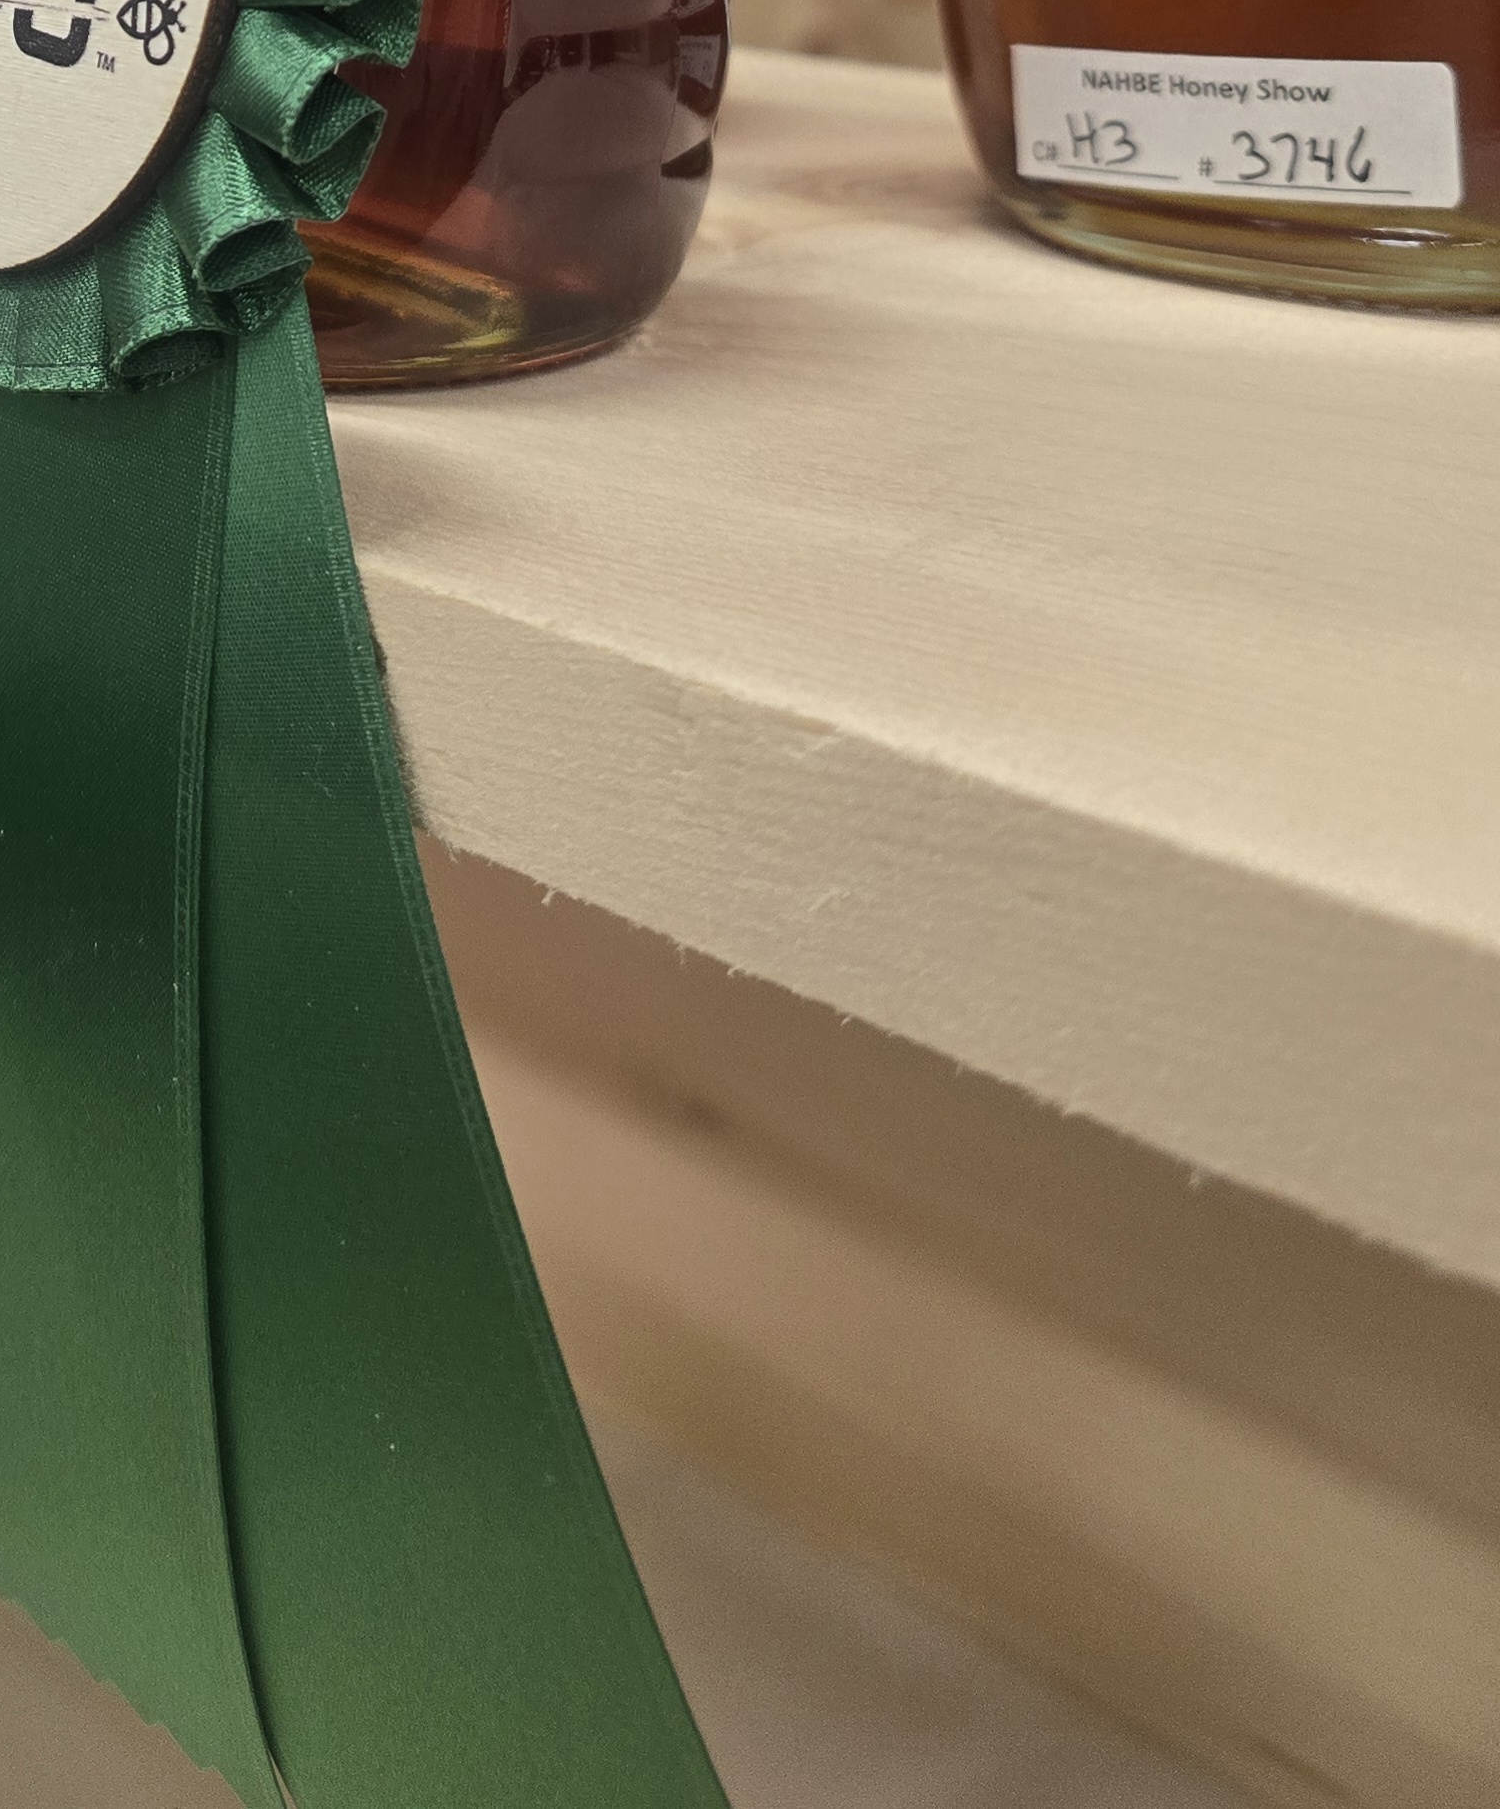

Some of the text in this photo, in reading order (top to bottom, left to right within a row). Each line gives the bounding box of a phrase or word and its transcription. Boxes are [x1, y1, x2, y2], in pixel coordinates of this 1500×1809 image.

[1081, 69, 1331, 104] NAHBE Honey Show
[1066, 111, 1138, 167] H3
[1232, 125, 1373, 183] 3746
